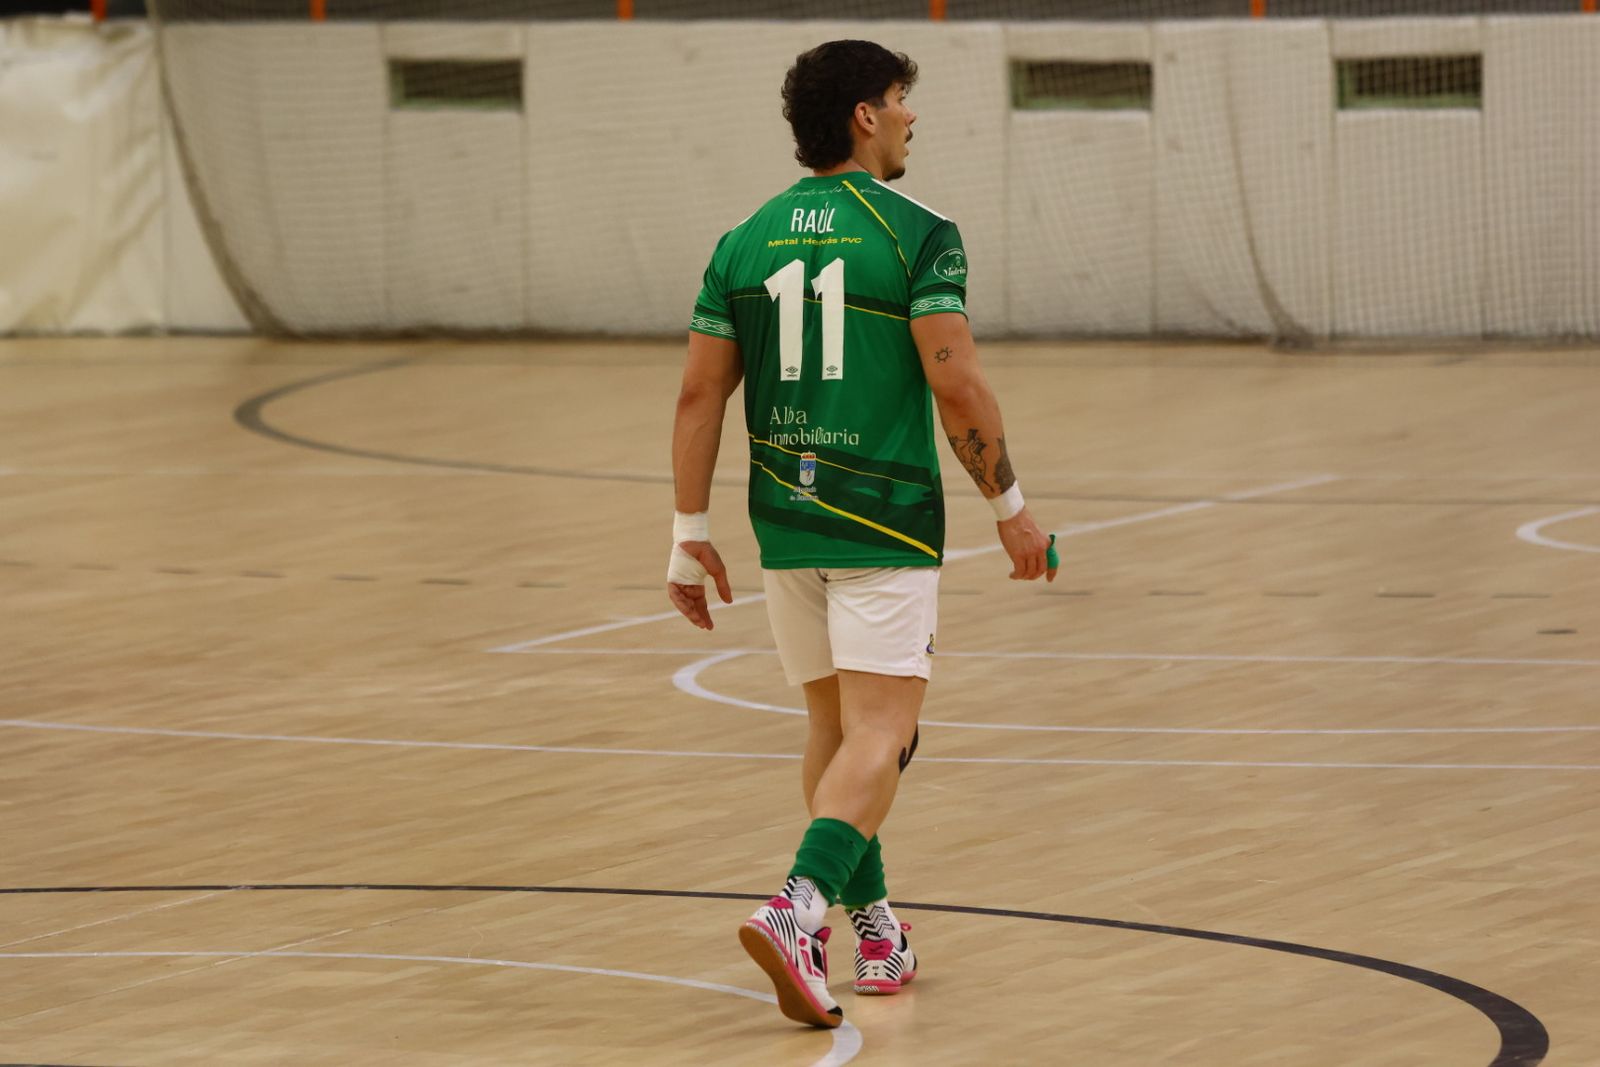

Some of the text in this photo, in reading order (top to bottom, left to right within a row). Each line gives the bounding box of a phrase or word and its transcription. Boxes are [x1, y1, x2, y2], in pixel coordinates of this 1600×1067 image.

[791, 201, 835, 233] RAÚL
[768, 238, 797, 248] Metal
[763, 257, 844, 381] 11
[770, 406, 807, 424] Alba
